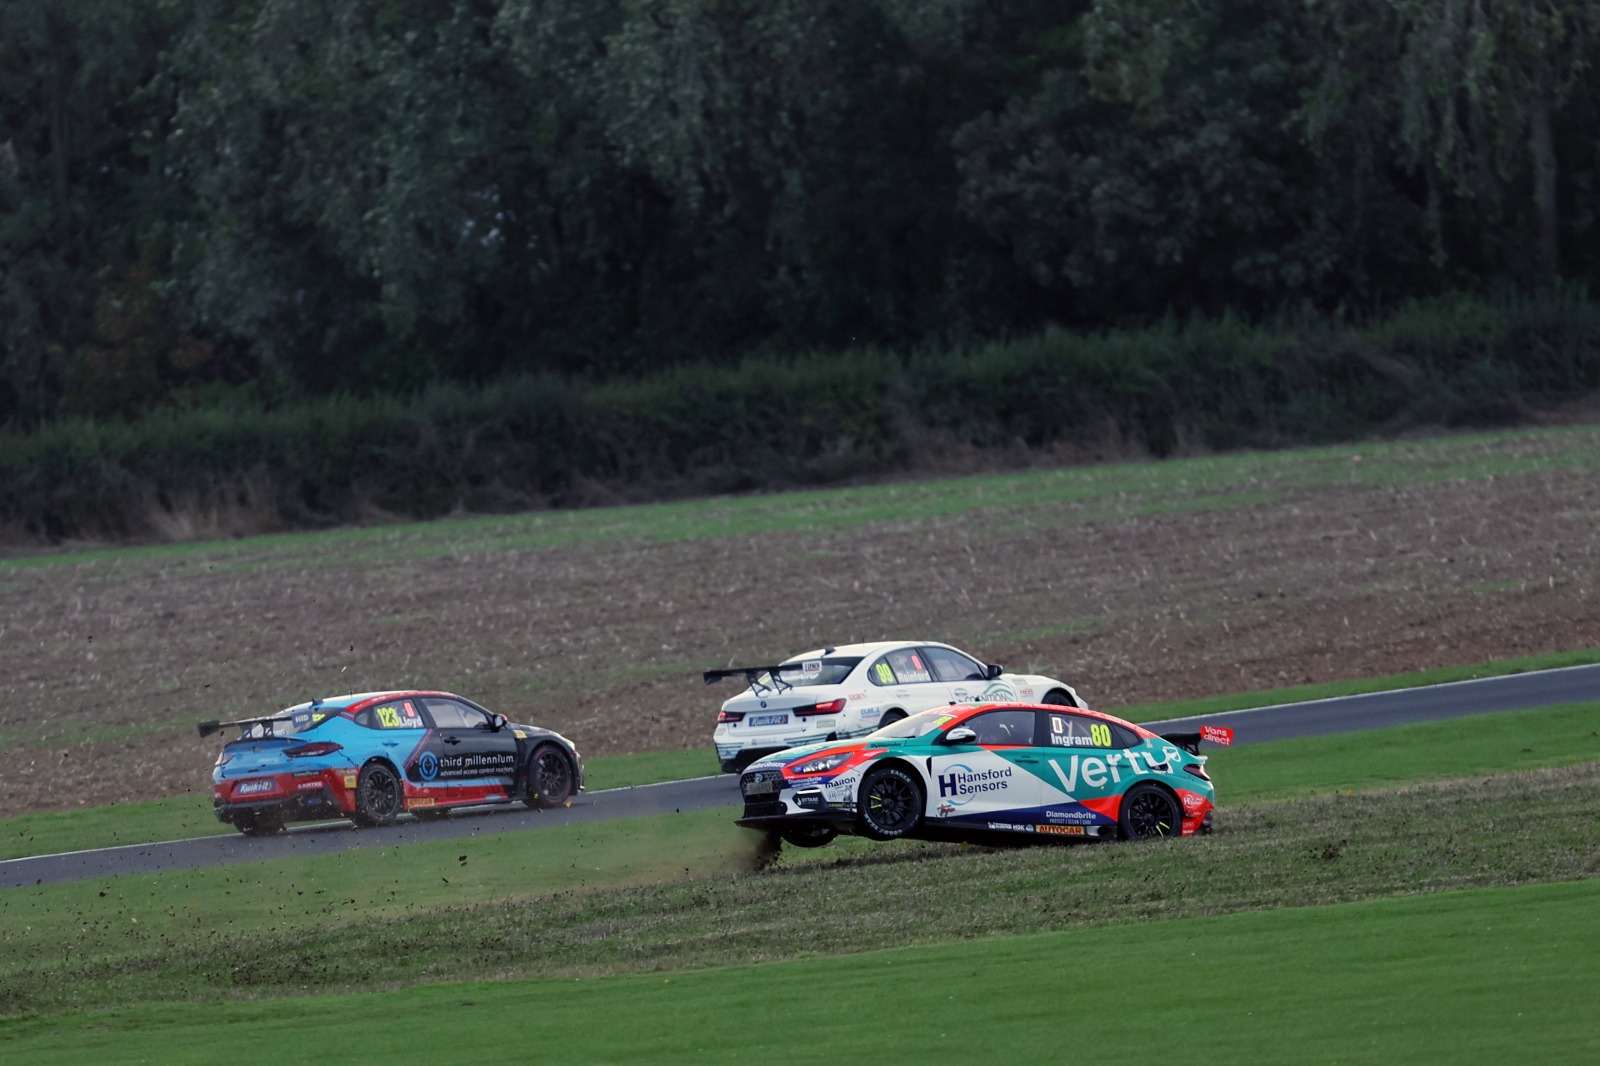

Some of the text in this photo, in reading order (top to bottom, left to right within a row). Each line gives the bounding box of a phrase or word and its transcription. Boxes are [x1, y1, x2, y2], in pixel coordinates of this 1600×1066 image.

[876, 663, 894, 684] 99
[897, 671, 929, 682] Rainford
[377, 707, 399, 727] 123
[399, 715, 423, 728] Lloyd
[1090, 723, 1112, 747] 80
[1205, 725, 1228, 737] Vans
[1050, 732, 1093, 747] Ingram
[1203, 734, 1231, 746] direct
[440, 754, 514, 767] third millennium
[440, 769, 463, 777] advanced
[958, 766, 1012, 783] Hansford
[938, 773, 958, 797] H
[959, 780, 1008, 795] Sensors
[1045, 810, 1097, 820] Diamondbrite
[1039, 825, 1082, 835] AUTOCAR
